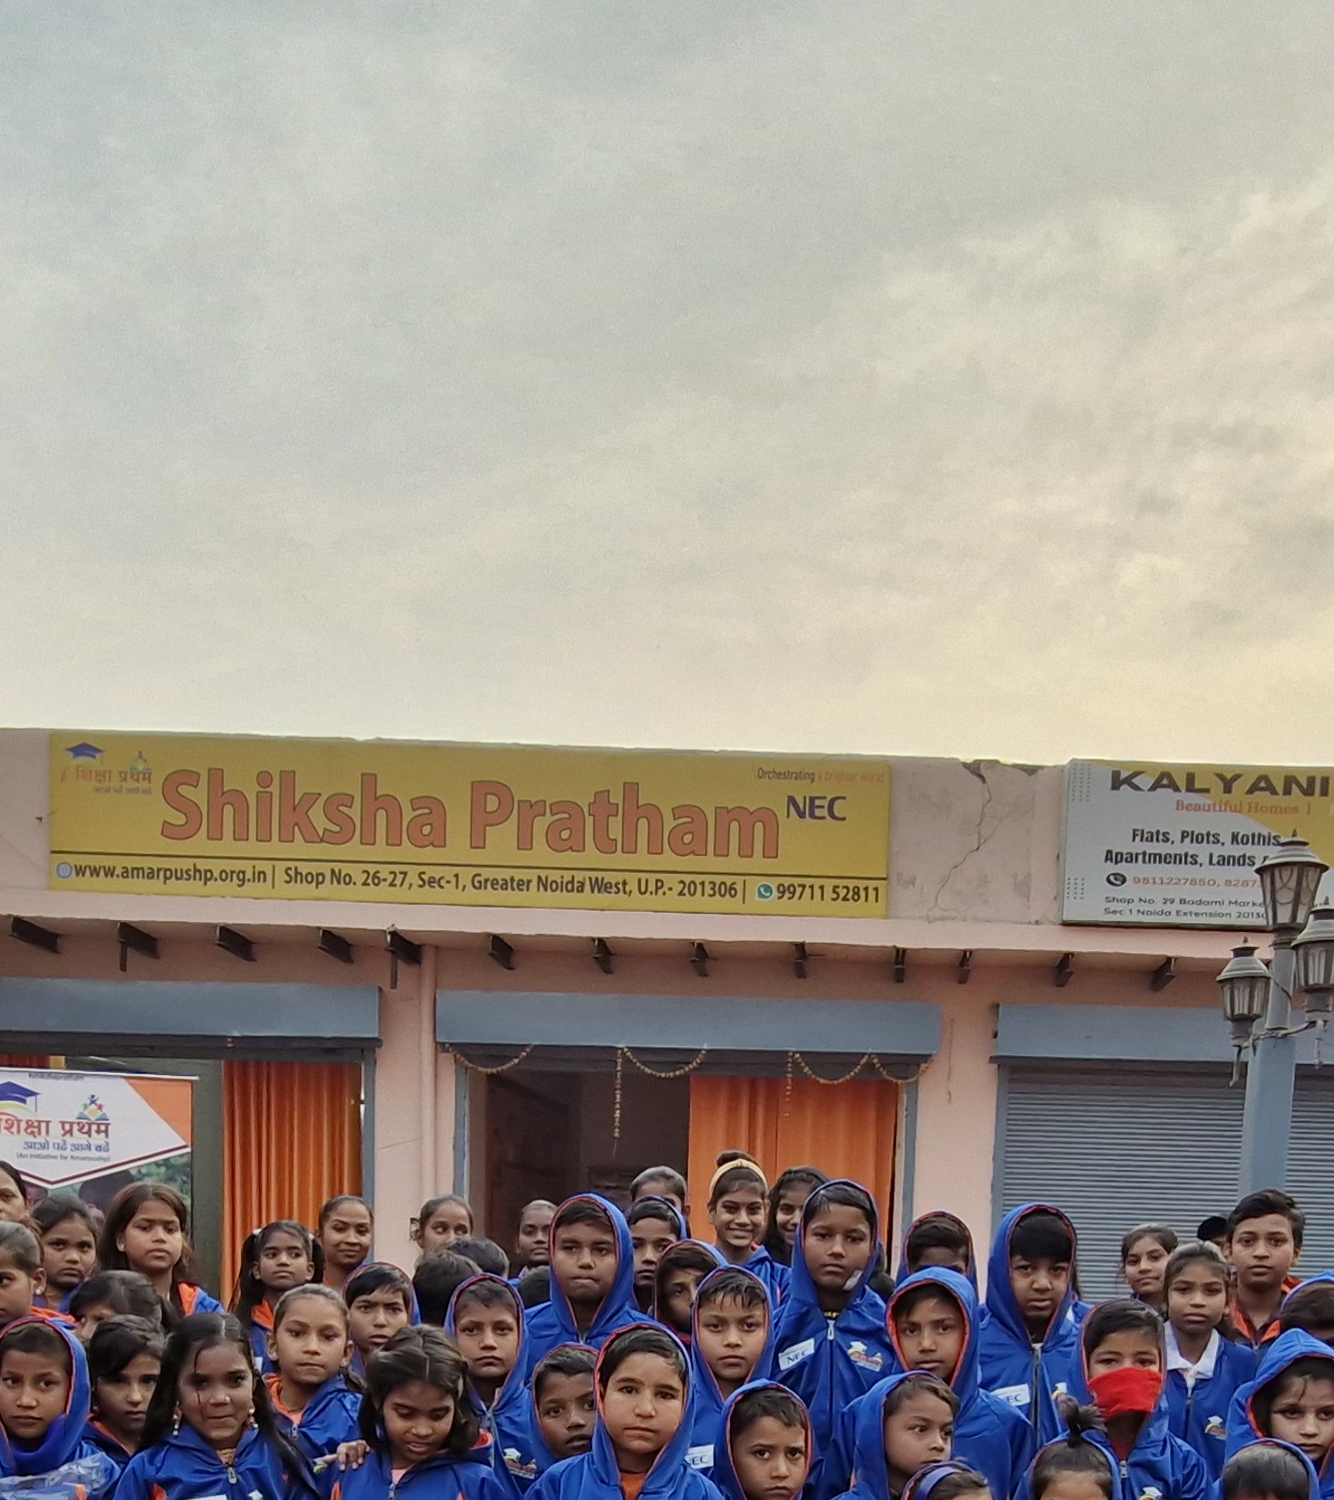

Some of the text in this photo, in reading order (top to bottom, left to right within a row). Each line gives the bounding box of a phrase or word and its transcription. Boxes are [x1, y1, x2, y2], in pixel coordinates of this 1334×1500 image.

[75, 766, 153, 785] शिक्षा प्रथम
[757, 767, 816, 784] Orchestrating
[1110, 770, 1330, 798] KALYANI
[160, 768, 780, 859] Shiksha Pratham
[786, 795, 847, 821] NEC
[1175, 800, 1243, 813] Beautiful
[1248, 802, 1300, 815] Homes
[1132, 828, 1175, 846] Flats,
[1180, 830, 1225, 847] Plots,
[1104, 850, 1256, 868] Apartments, Lands
[74, 863, 267, 887] www.amarpushp.org.in
[284, 866, 325, 889] Shop
[330, 868, 357, 886] No.
[361, 869, 413, 889] 26-27,
[417, 871, 466, 893] Sec-1,
[471, 873, 533, 891] Greater
[537, 875, 585, 893] Noida
[588, 877, 632, 897] West,
[677, 880, 737, 898] 201306
[777, 883, 825, 901] 99711
[830, 885, 879, 903] 52811
[1105, 896, 1135, 905] Shop
[1180, 898, 1225, 907] Badami
[1228, 900, 1267, 909] Marke
[1104, 908, 1125, 916] Sec
[1137, 909, 1172, 917] Noida
[1176, 910, 1232, 918] Extension
[59, 1119, 111, 1142] प्रथम
[786, 1350, 808, 1365] NEC
